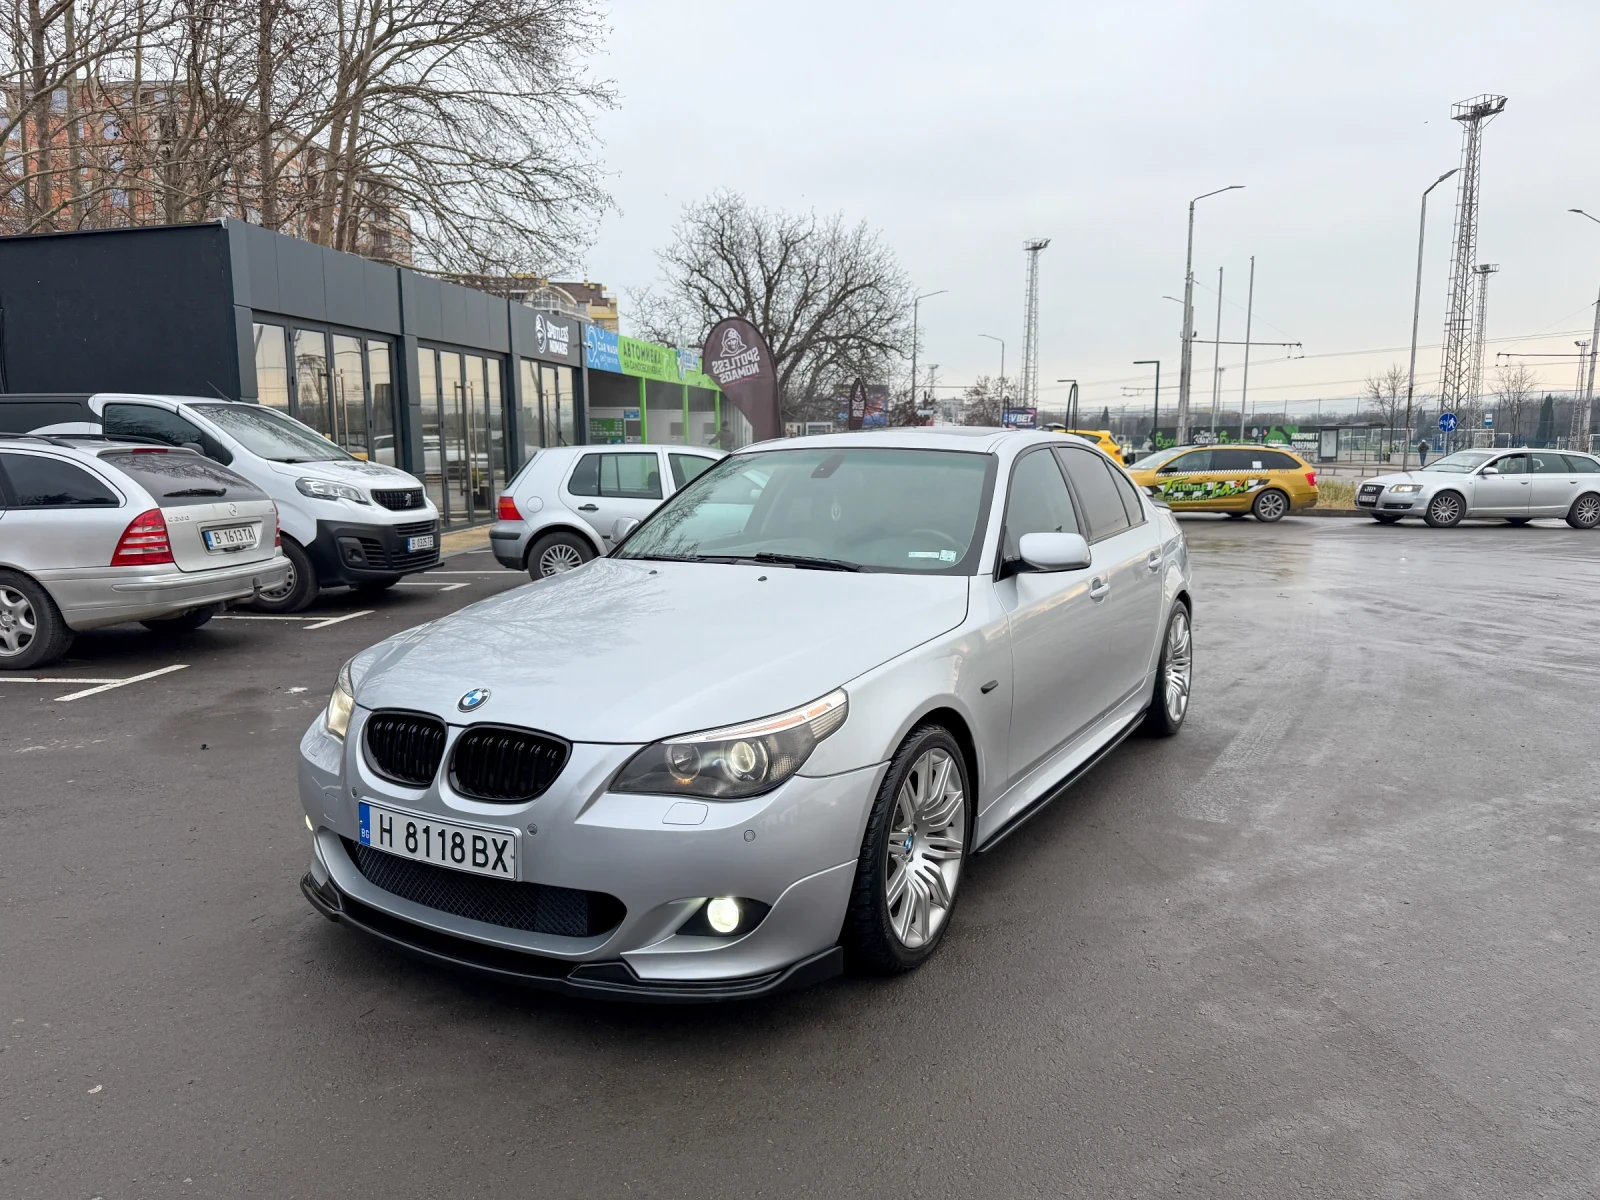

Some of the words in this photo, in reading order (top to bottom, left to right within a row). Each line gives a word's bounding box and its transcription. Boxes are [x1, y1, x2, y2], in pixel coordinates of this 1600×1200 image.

[547, 320, 569, 342] SPOTLESS
[549, 340, 568, 356] NOMADS
[623, 341, 661, 364] АВТОМИВКА
[361, 828, 370, 839] BG
